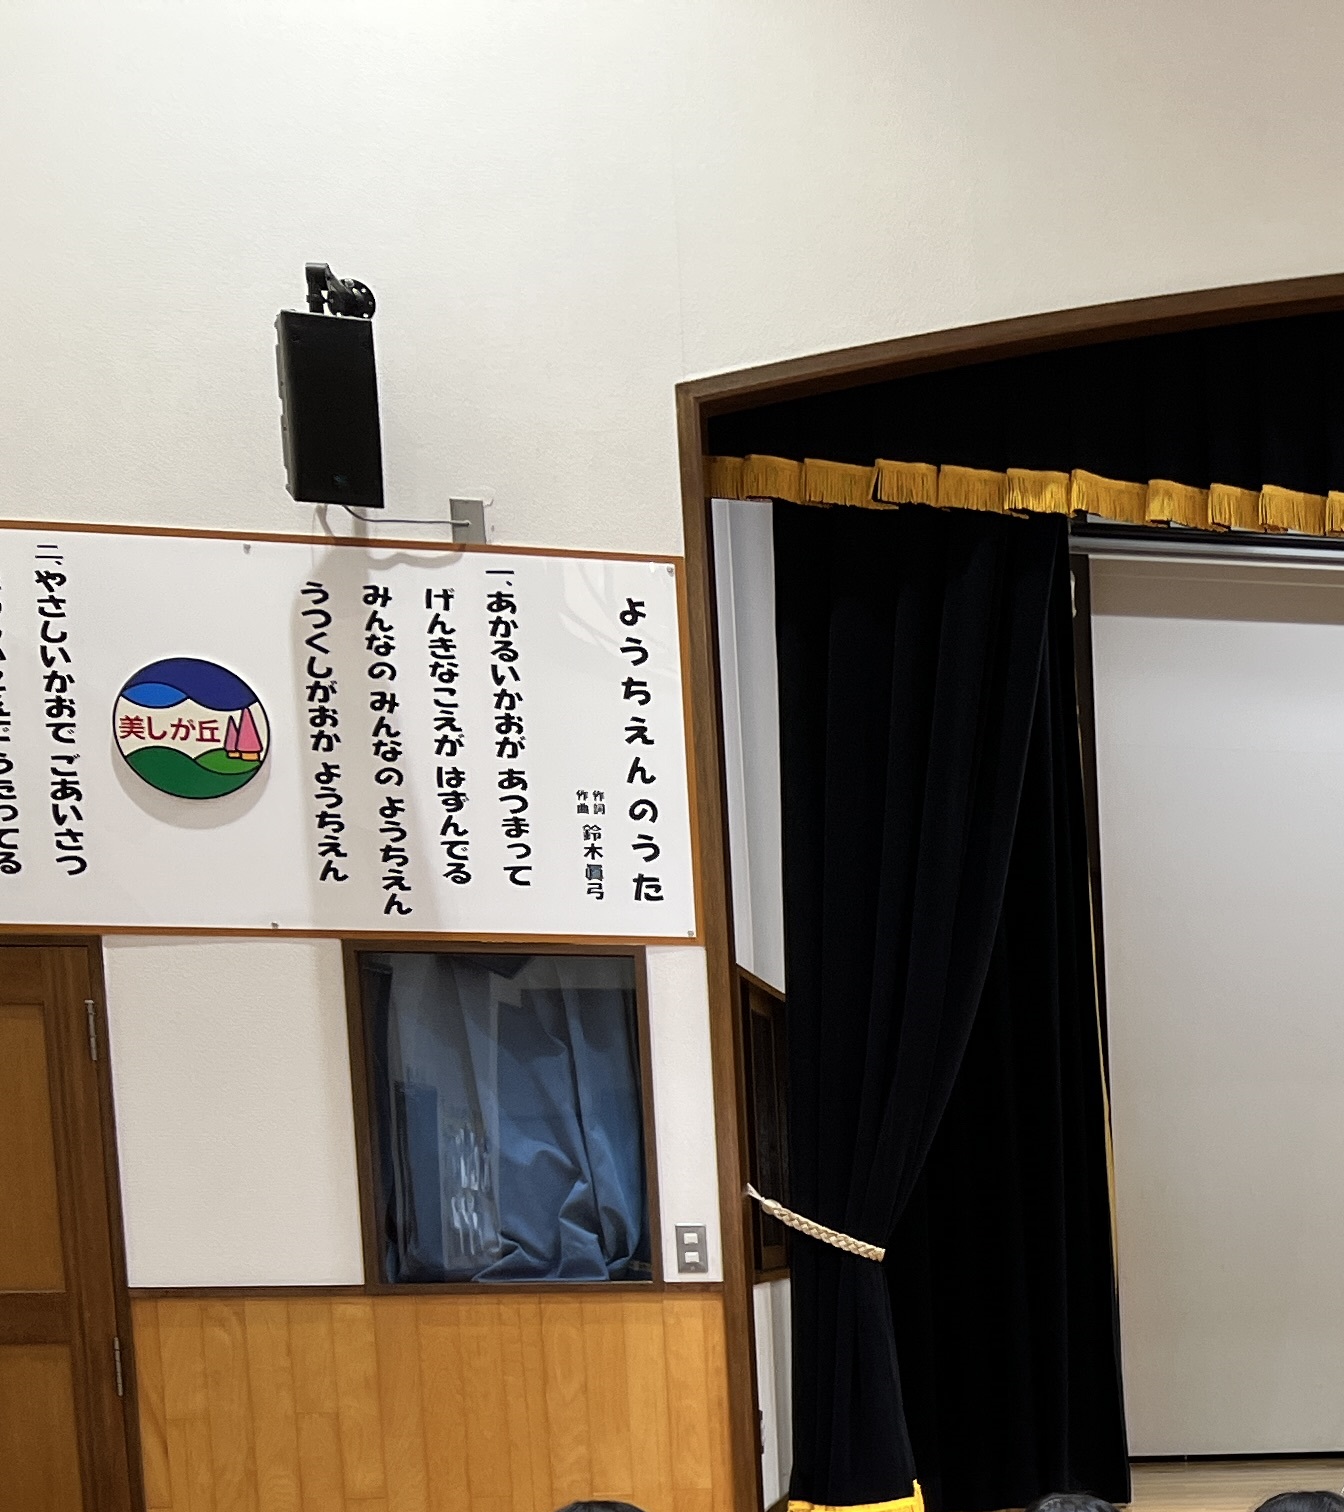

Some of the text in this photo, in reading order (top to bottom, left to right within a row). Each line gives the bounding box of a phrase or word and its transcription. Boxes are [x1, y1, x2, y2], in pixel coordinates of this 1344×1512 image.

[119, 714, 221, 743] 美しが丘
[619, 597, 664, 902] ようちえんのうた
